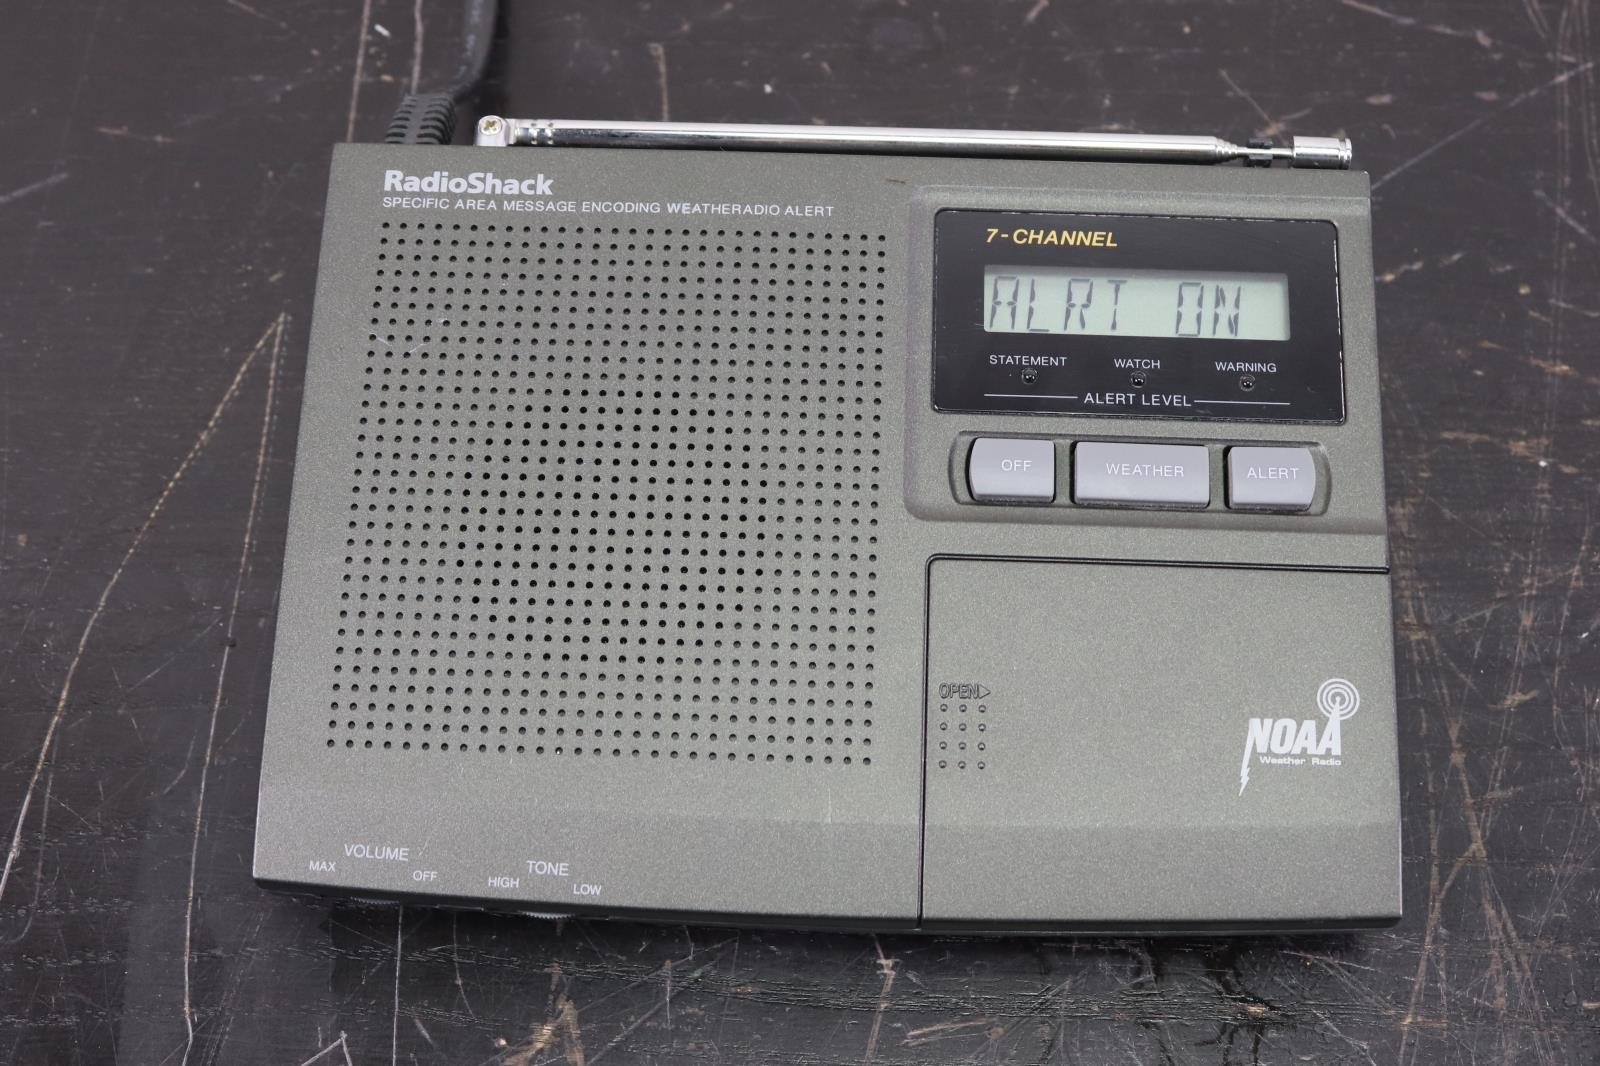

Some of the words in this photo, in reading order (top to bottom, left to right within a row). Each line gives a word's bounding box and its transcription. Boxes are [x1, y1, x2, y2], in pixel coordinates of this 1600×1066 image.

[384, 170, 554, 195] RadioShack
[382, 197, 450, 209] SPECIFIC
[454, 199, 498, 210] AREA
[503, 200, 576, 212] MESSAGE
[582, 201, 661, 213] ENCODING
[667, 203, 780, 215] WEATHERADIO
[784, 205, 834, 216] ALERT
[985, 228, 1118, 247] 7-CHANNEL
[989, 276, 1128, 332] ALRT
[1176, 282, 1242, 336] ON
[989, 355, 1068, 367] STATEMENT
[1114, 358, 1161, 370] WATCH
[1215, 361, 1277, 374] WARNING
[1084, 393, 1136, 406] ALERT
[1142, 394, 1192, 407] LEVEL
[1001, 459, 1033, 472] OFF
[1106, 463, 1184, 478] WEATHER
[1247, 466, 1300, 480] ALERT
[938, 682, 979, 699] OPEN
[1248, 717, 1342, 756] NOAA
[1259, 755, 1306, 765] Weather
[1311, 757, 1341, 766] Radio
[344, 844, 410, 862] VOLUME
[309, 860, 336, 873] MAX
[526, 860, 569, 877] TONE
[412, 870, 438, 882] OFF
[488, 875, 520, 889] HIGH
[573, 883, 602, 897] LOW
